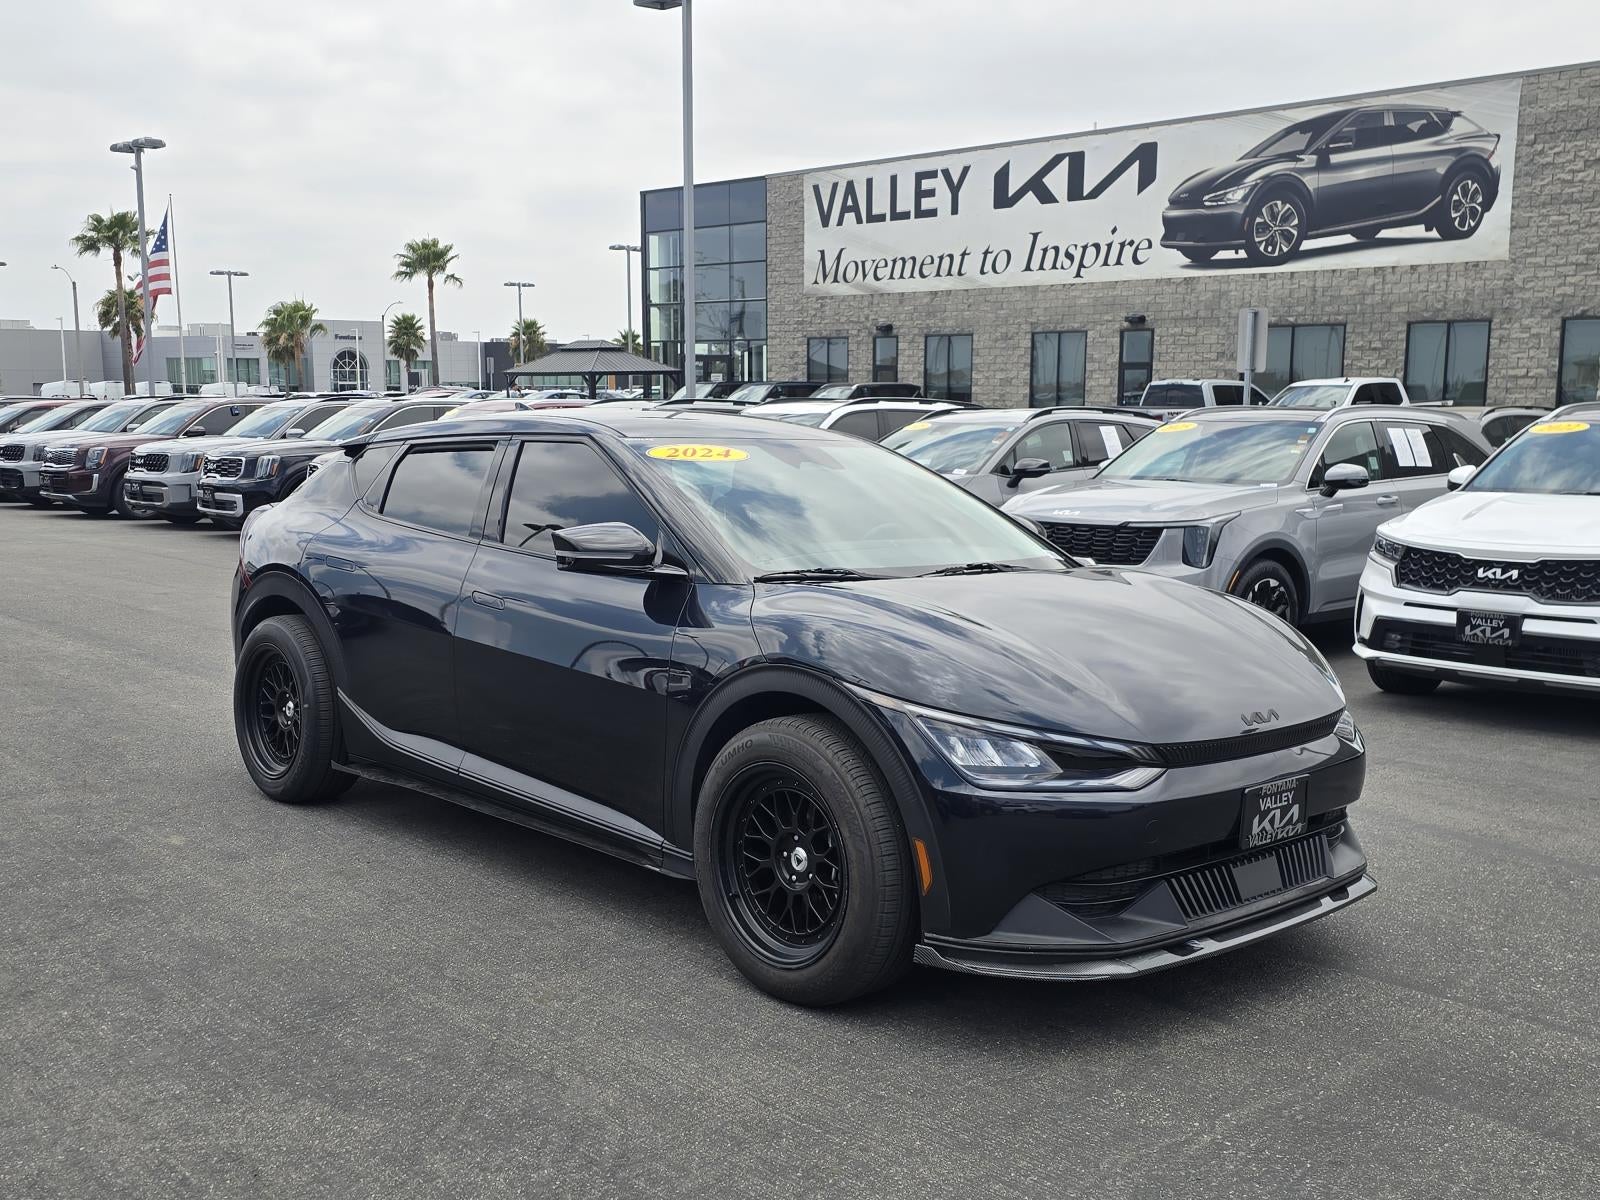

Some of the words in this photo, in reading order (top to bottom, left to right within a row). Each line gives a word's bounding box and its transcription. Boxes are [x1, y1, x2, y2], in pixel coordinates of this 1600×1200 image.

[812, 164, 971, 229] VALLEY
[993, 141, 1158, 210] KIA
[813, 246, 972, 285] Movement
[979, 244, 1012, 275] to
[1021, 225, 1154, 279] Inspire
[666, 447, 731, 458] 2024
[1477, 566, 1519, 580] KIA
[1464, 624, 1510, 639] KIA
[1470, 617, 1505, 628] VALLEY
[1240, 709, 1280, 727] KIA
[714, 739, 753, 773] KUMHO
[1260, 790, 1295, 812] VALLEY
[1251, 803, 1300, 837] KIA
[1248, 828, 1276, 849] VALLEY
